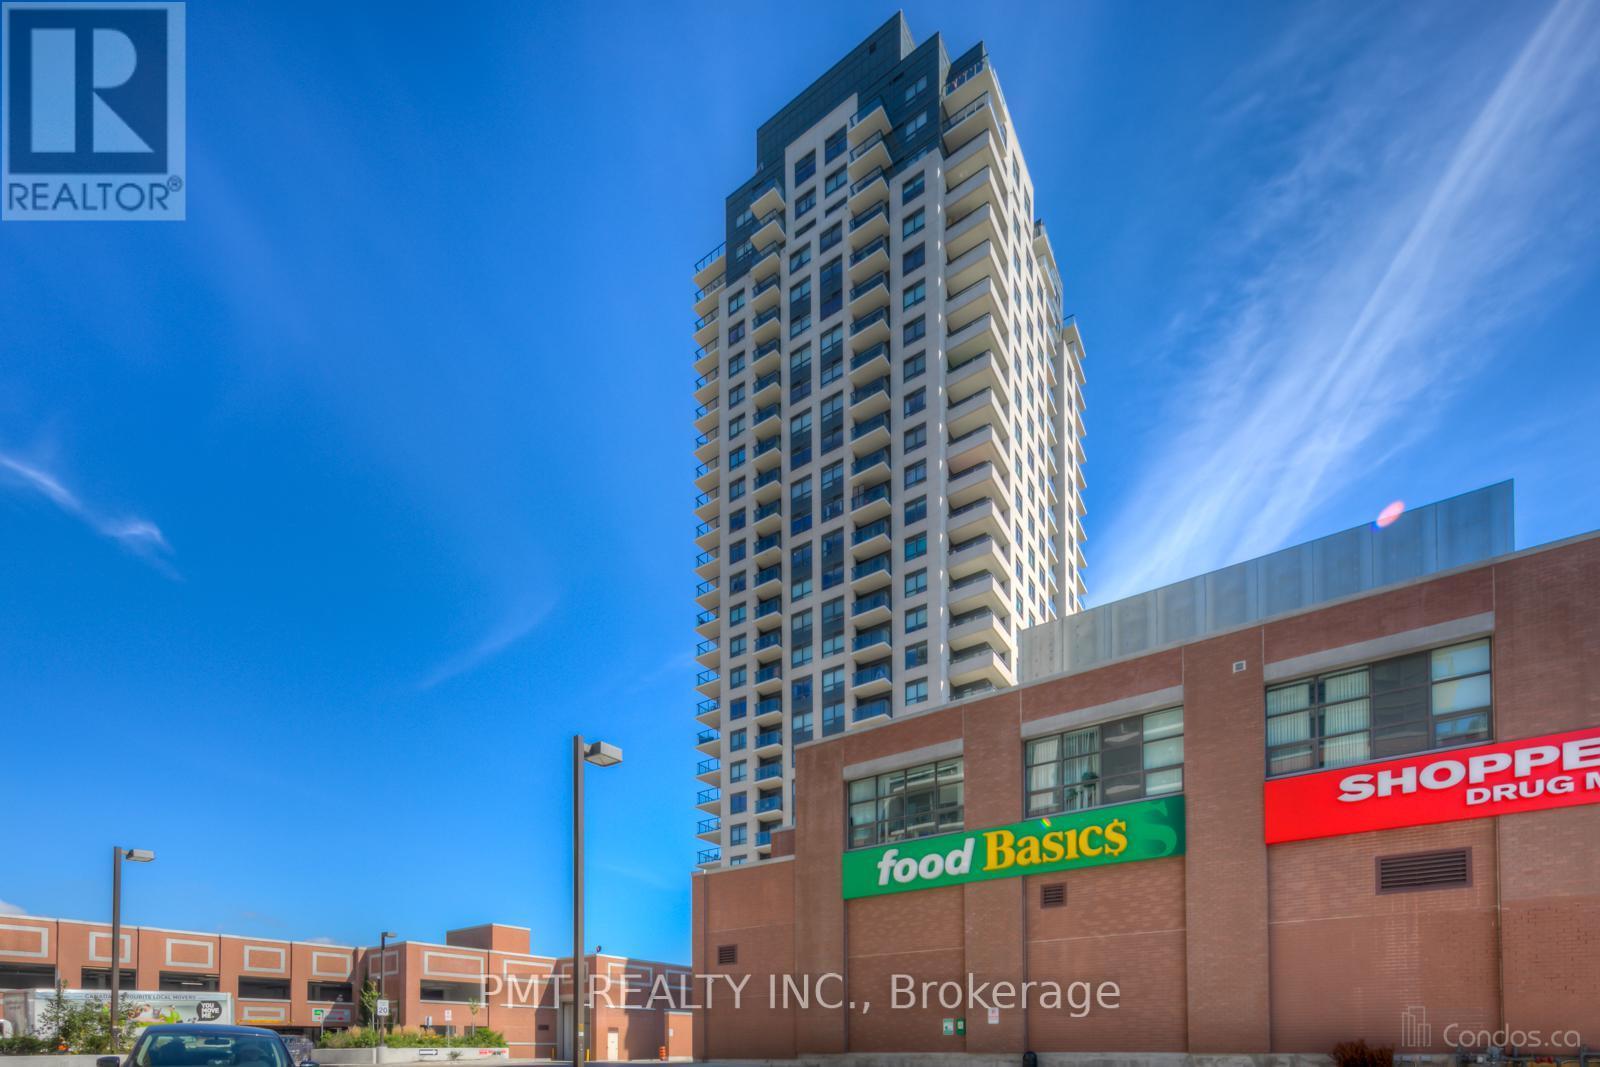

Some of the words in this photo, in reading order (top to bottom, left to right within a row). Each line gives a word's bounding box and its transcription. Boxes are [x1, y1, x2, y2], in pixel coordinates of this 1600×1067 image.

[1337, 737, 1600, 803] SHOPPE
[1466, 775, 1575, 805] DRUG
[877, 837, 975, 886] food
